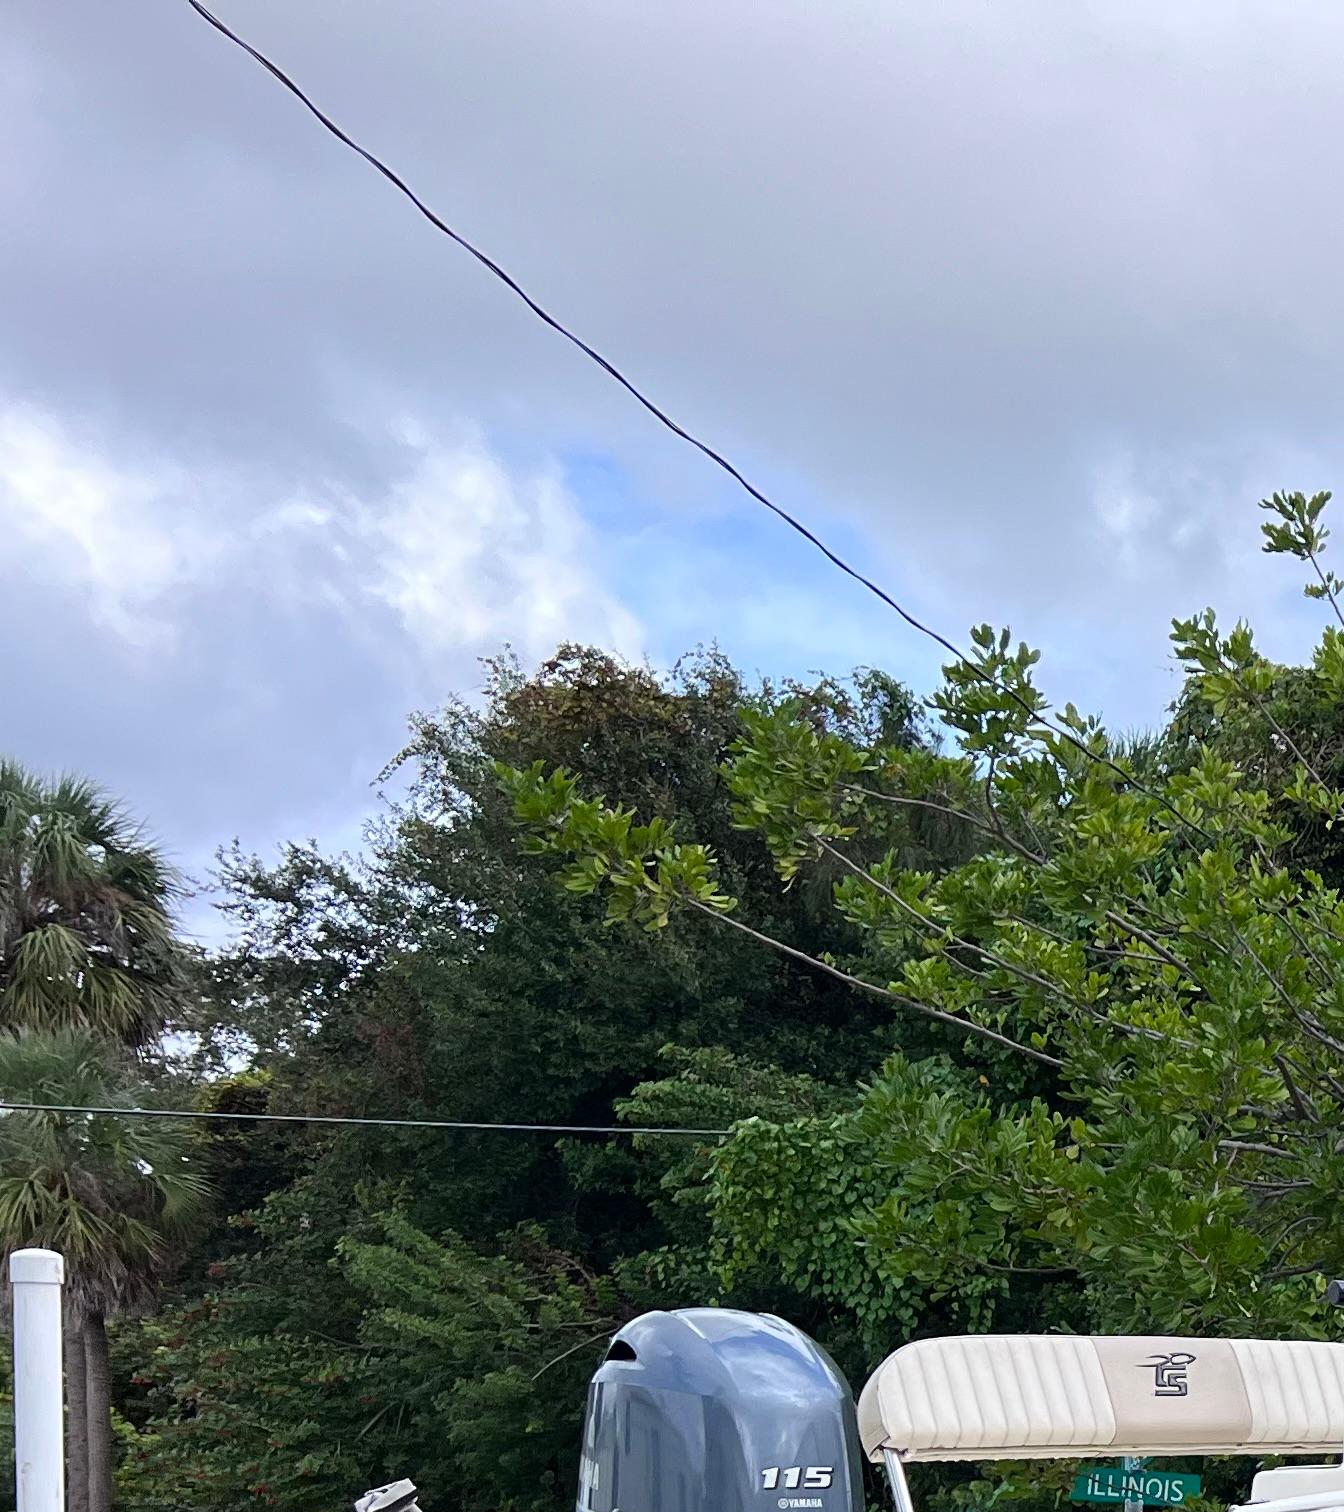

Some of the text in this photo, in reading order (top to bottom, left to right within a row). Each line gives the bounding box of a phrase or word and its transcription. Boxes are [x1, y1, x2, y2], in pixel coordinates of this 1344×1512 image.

[761, 1466, 833, 1490] 115
[1087, 1473, 1184, 1502] ILLINOIS
[788, 1498, 823, 1509] YAMAHA
